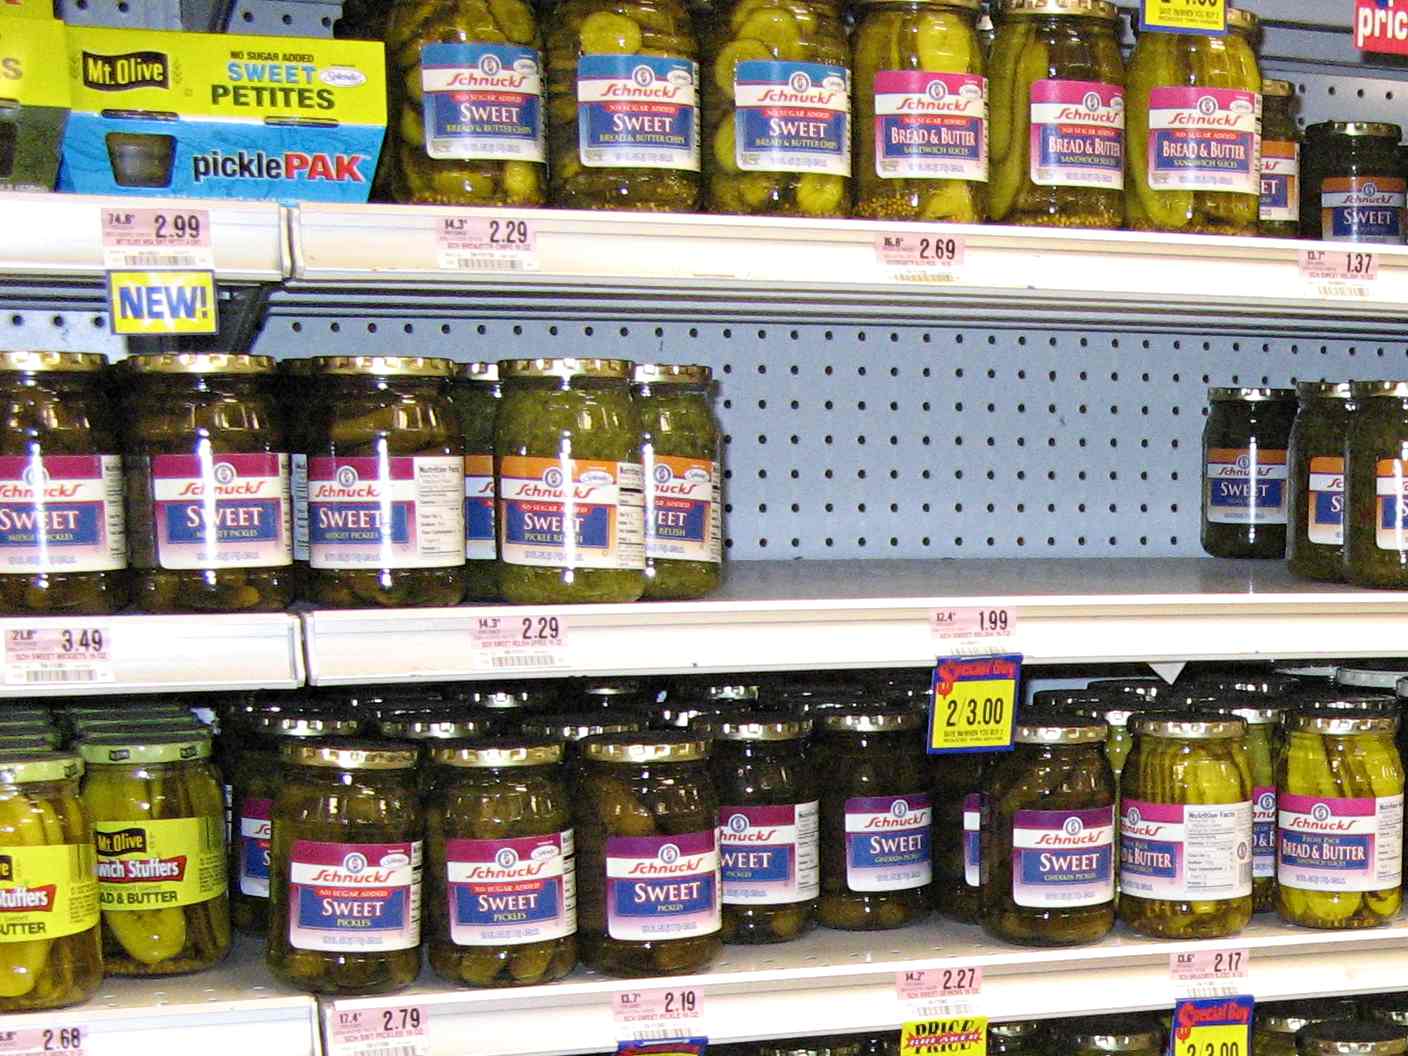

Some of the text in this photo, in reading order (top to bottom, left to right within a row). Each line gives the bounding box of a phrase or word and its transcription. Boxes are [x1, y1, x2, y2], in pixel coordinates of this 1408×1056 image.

[230, 52, 314, 62] NO SUGAR ADDED
[228, 61, 317, 84] SWEET
[211, 85, 335, 110] PETITES
[460, 104, 518, 125] SWEET
[769, 119, 826, 139] SWEET
[891, 127, 975, 145] BREAD & BUTTER
[1163, 140, 1245, 159] BREAD & BUTTER
[154, 214, 200, 240] 2.99
[1344, 209, 1392, 226] SWEET
[489, 221, 528, 244] 2.29
[920, 238, 956, 260] 2.69
[1346, 253, 1371, 273] 1.37
[119, 285, 209, 320] NEW!
[1220, 481, 1269, 498] SWEET
[62, 630, 103, 652] 3.49
[870, 835, 922, 853] SWEET
[1312, 844, 1321, 859] &
[1323, 844, 1365, 861] BUTTER
[128, 859, 179, 877] Stuffers
[1040, 853, 1099, 872] SWEET
[128, 891, 178, 906] BUTTER
[479, 893, 537, 912] SWEET
[634, 882, 700, 903] SWEET
[322, 898, 384, 918] SWEET
[1214, 952, 1242, 972] 2.17
[943, 968, 975, 990] 2.27
[665, 991, 695, 1012] 2.19
[383, 1009, 420, 1031] 2.79
[43, 1027, 81, 1050] 2.68
